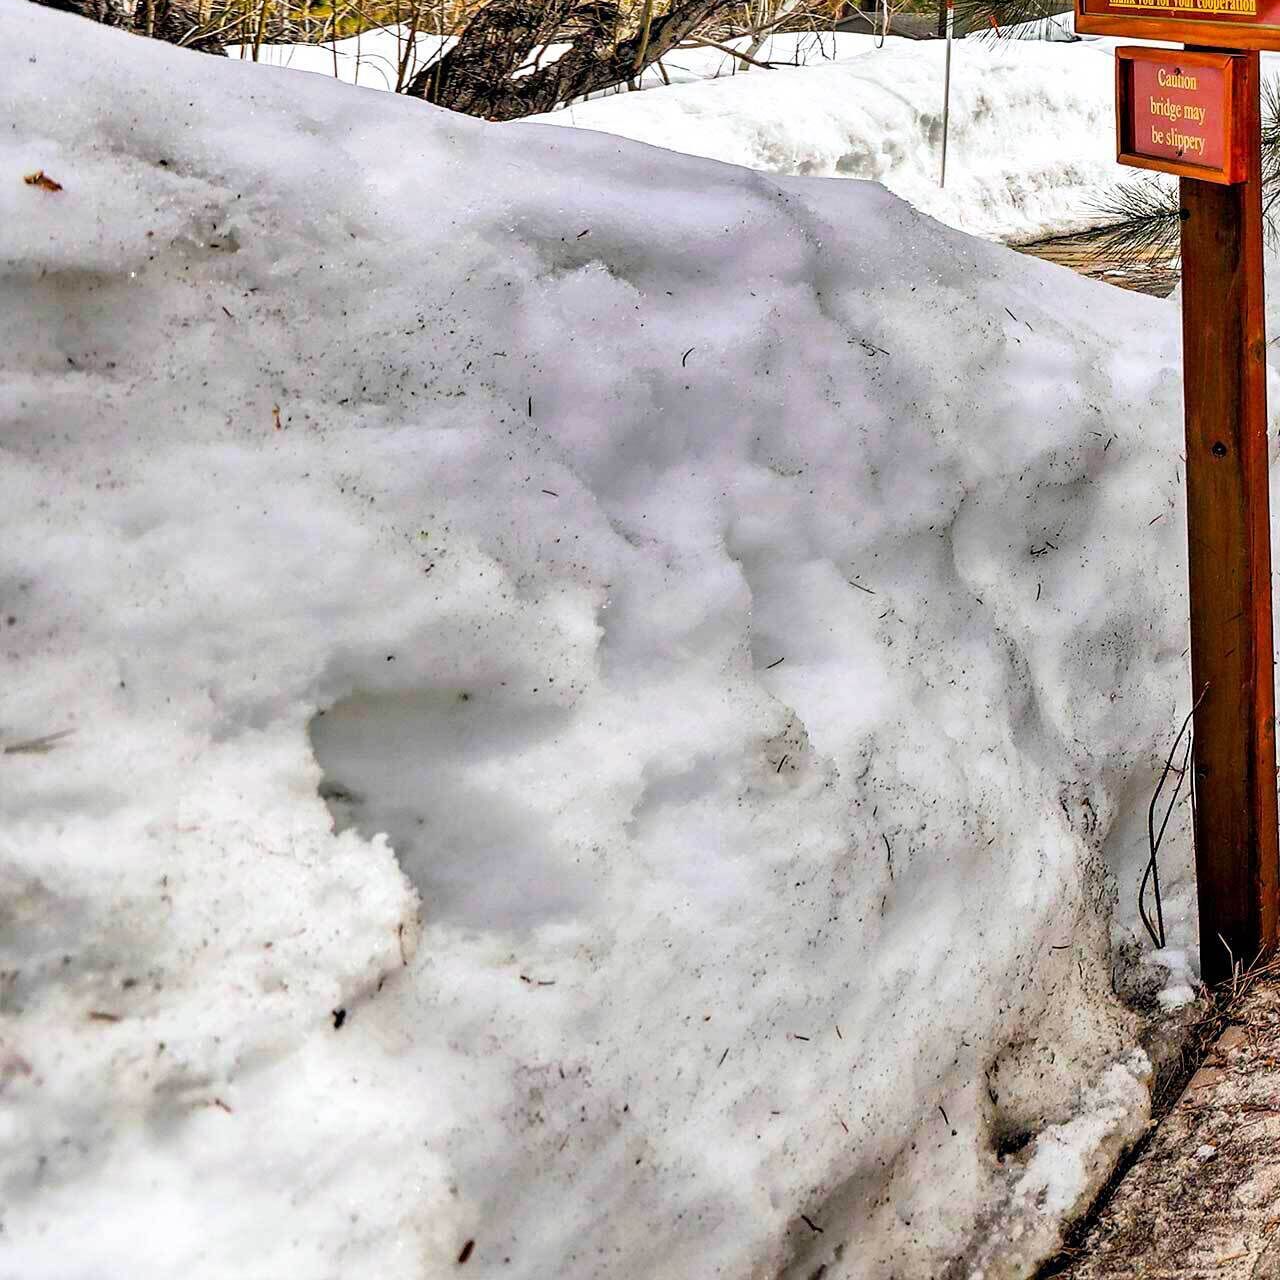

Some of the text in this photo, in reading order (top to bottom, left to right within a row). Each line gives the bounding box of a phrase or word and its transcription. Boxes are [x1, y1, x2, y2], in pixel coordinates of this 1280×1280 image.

[1157, 68, 1197, 90] Caution
[1150, 96, 1206, 126] bridge may
[1151, 125, 1206, 156] be slippery
